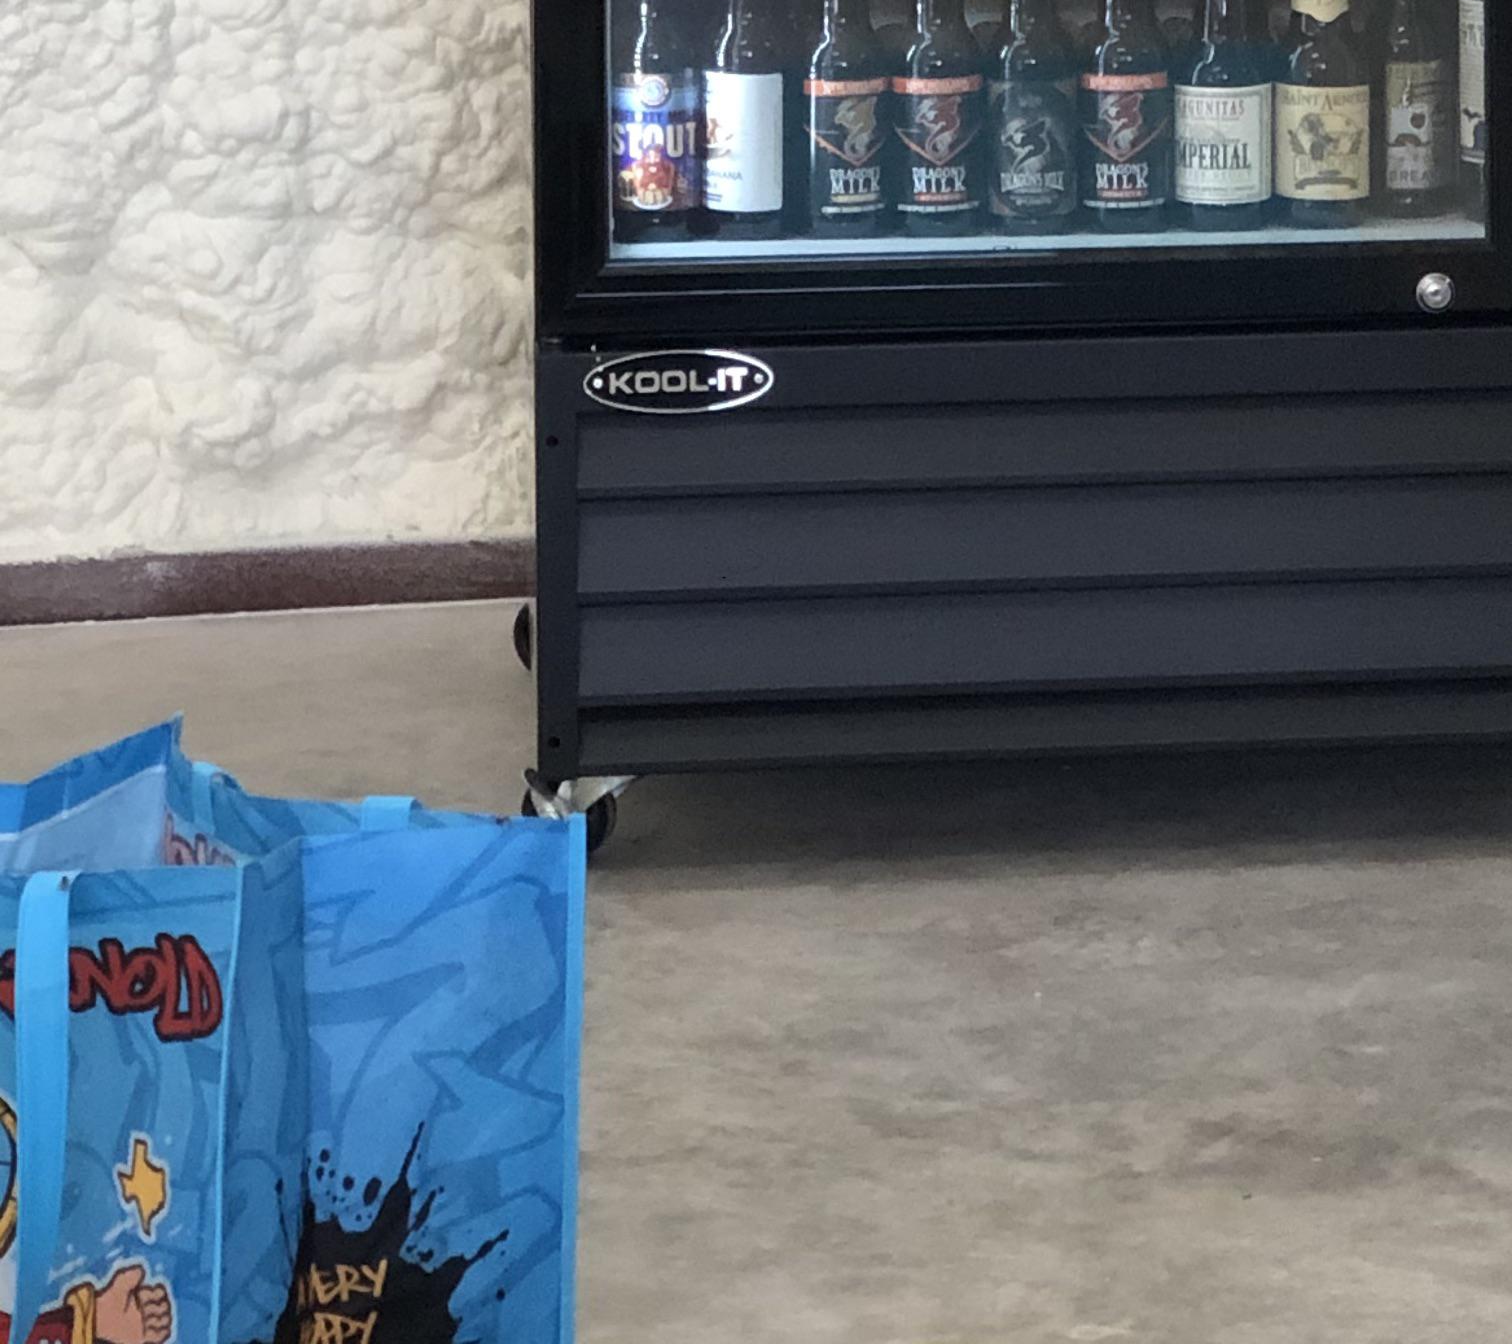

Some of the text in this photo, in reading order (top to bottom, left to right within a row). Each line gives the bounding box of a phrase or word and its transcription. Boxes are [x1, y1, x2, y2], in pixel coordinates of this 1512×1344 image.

[1175, 99, 1246, 117] AGUNITAS
[612, 120, 698, 160] STOUT
[1176, 141, 1253, 170] MPERIAL
[831, 177, 881, 195] MILK
[912, 175, 967, 193] MILK
[1096, 172, 1149, 189] MILK
[0, 932, 223, 1043] NOLD
